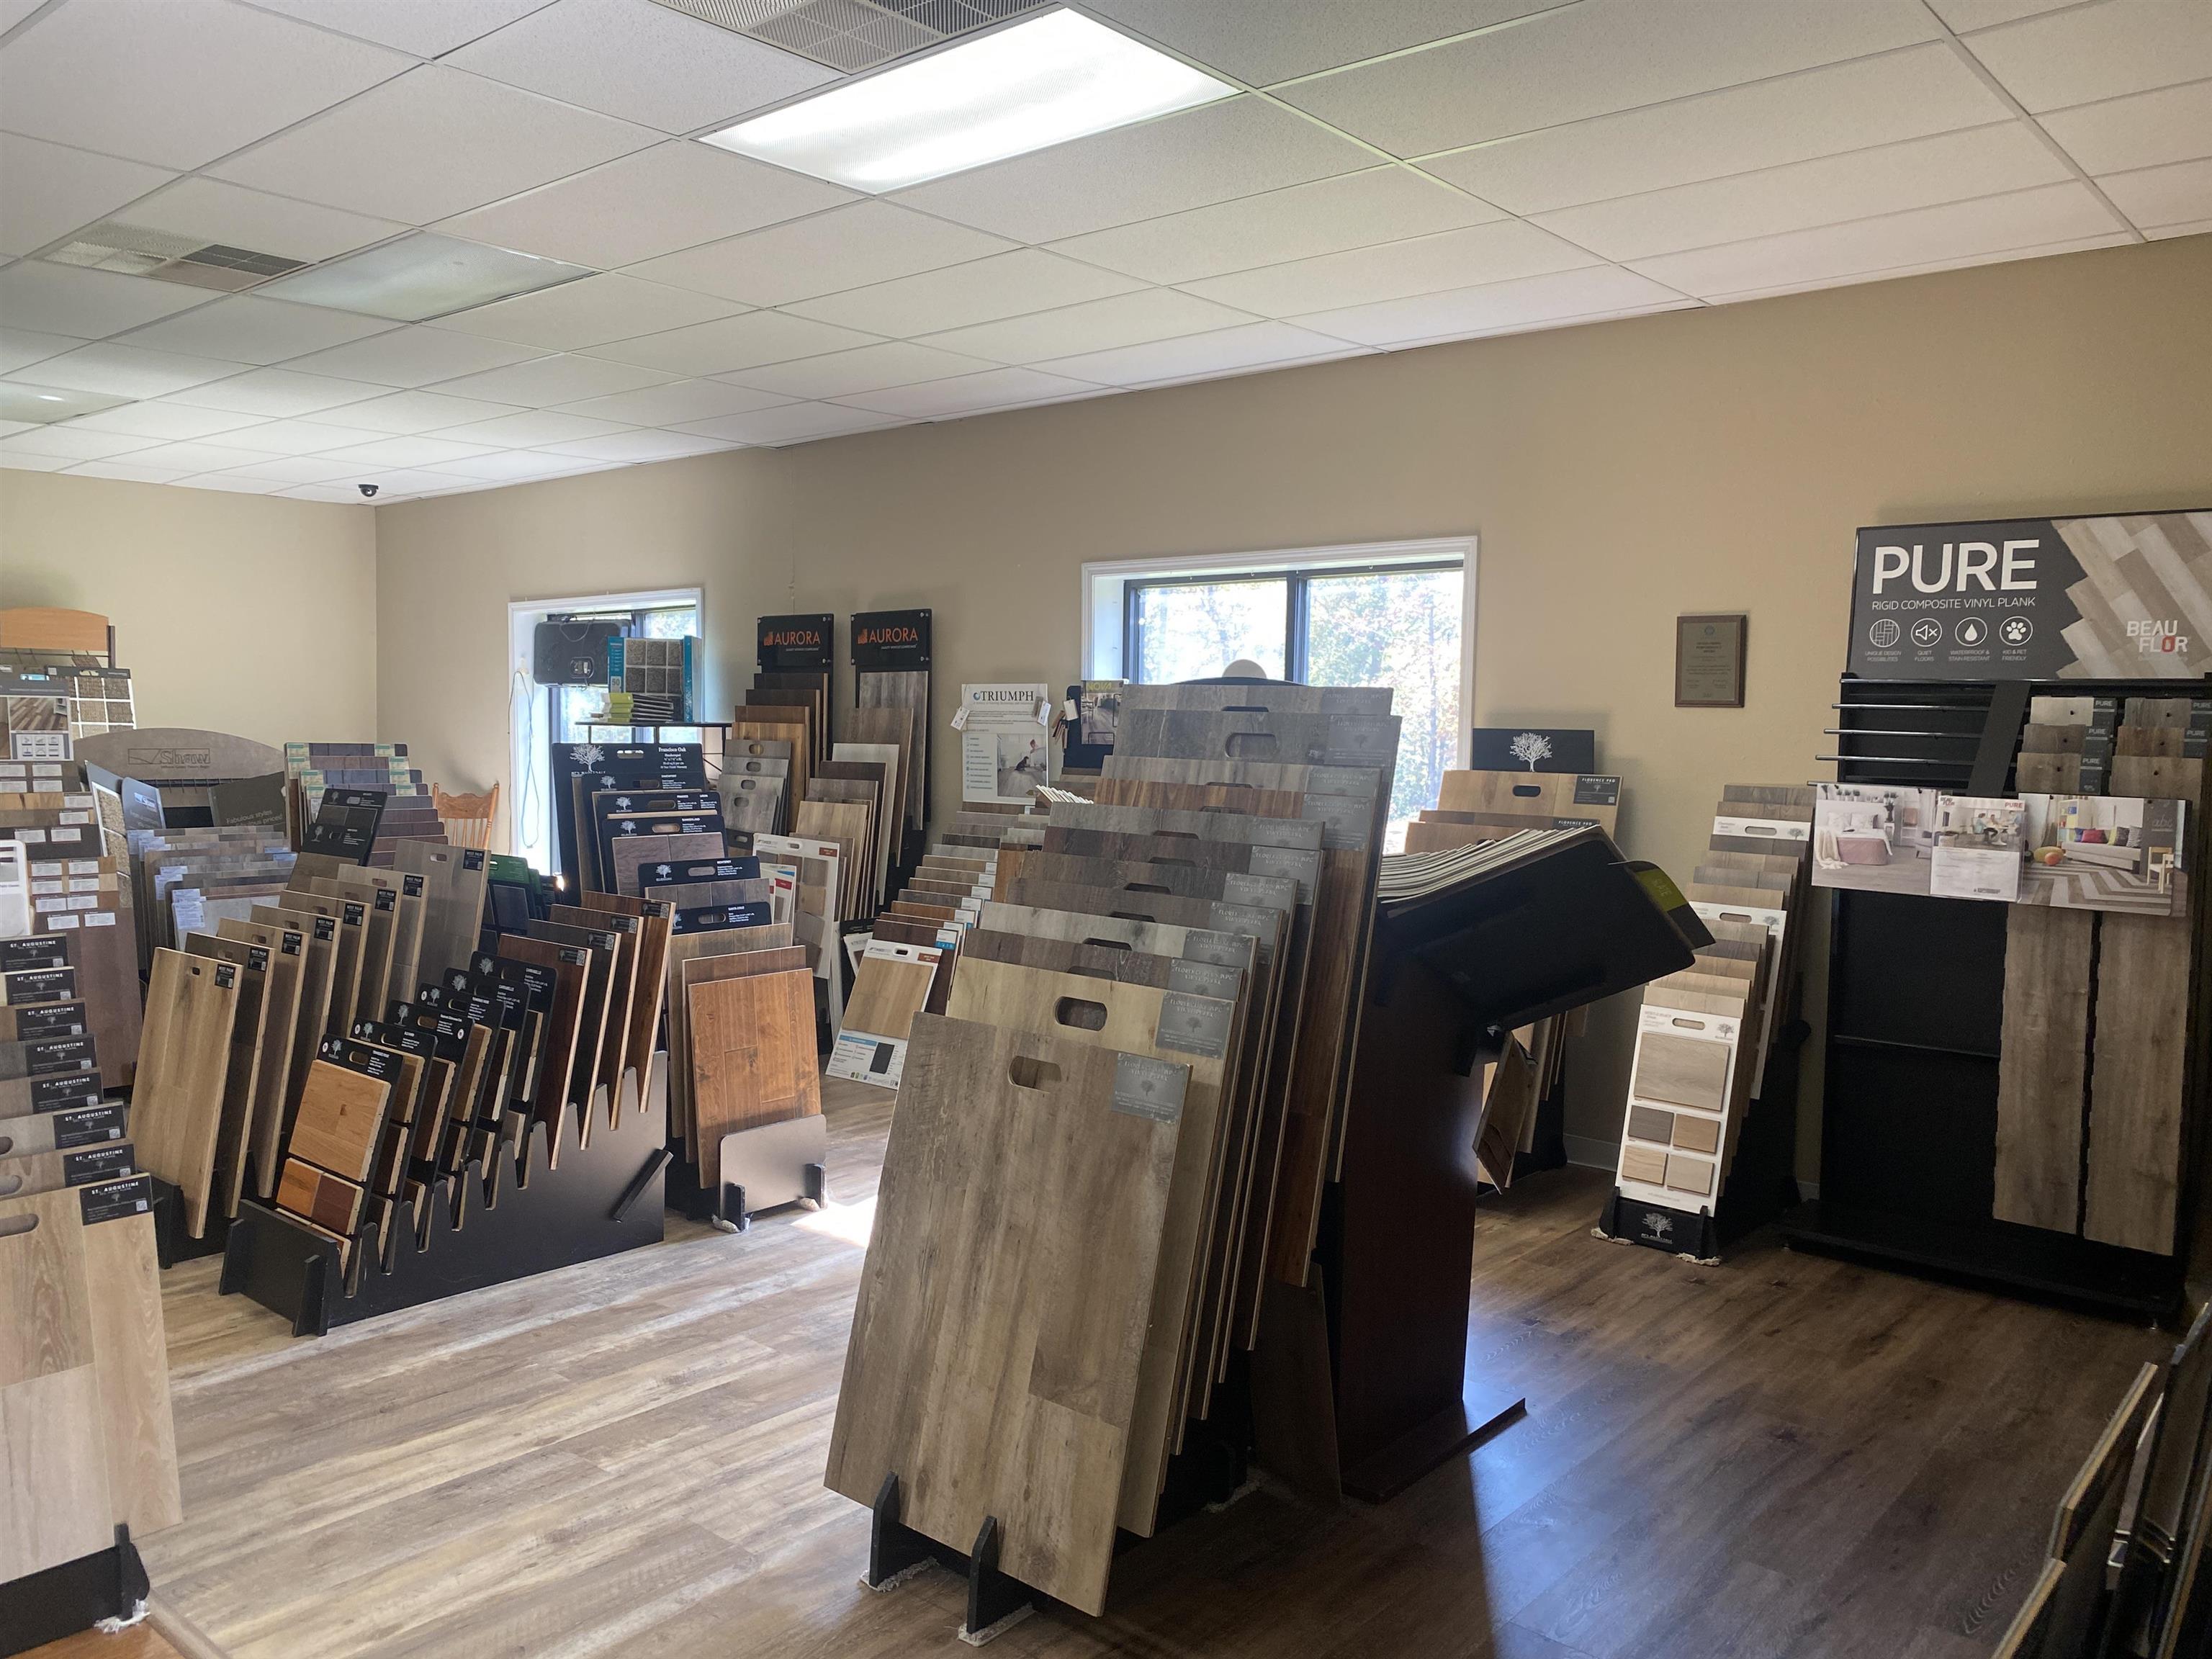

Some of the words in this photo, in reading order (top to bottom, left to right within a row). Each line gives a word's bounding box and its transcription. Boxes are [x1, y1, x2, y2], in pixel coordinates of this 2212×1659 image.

[1872, 539, 2039, 594] PURE
[1872, 600, 1899, 611] RIGID
[1901, 598, 1961, 610] COMPOSITE
[1964, 598, 1995, 608] VINYL
[1997, 596, 2036, 608] PLANK
[869, 628, 918, 643] AURORA
[2126, 620, 2178, 637] BEAU
[774, 631, 820, 645] AURORA
[2139, 636, 2188, 652] FLOR
[1087, 682, 1112, 691] NOVA
[981, 691, 1034, 701] TRIUMPH
[160, 750, 210, 764] Shaw
[225, 814, 254, 824] Fabulous
[2153, 814, 2173, 828] abc
[55, 1077, 90, 1086] AUGUSTINE
[78, 1110, 112, 1119] AUGUSTINE
[88, 1149, 122, 1159] AUGUSTINE
[104, 1182, 138, 1192] AUGUSTINE
